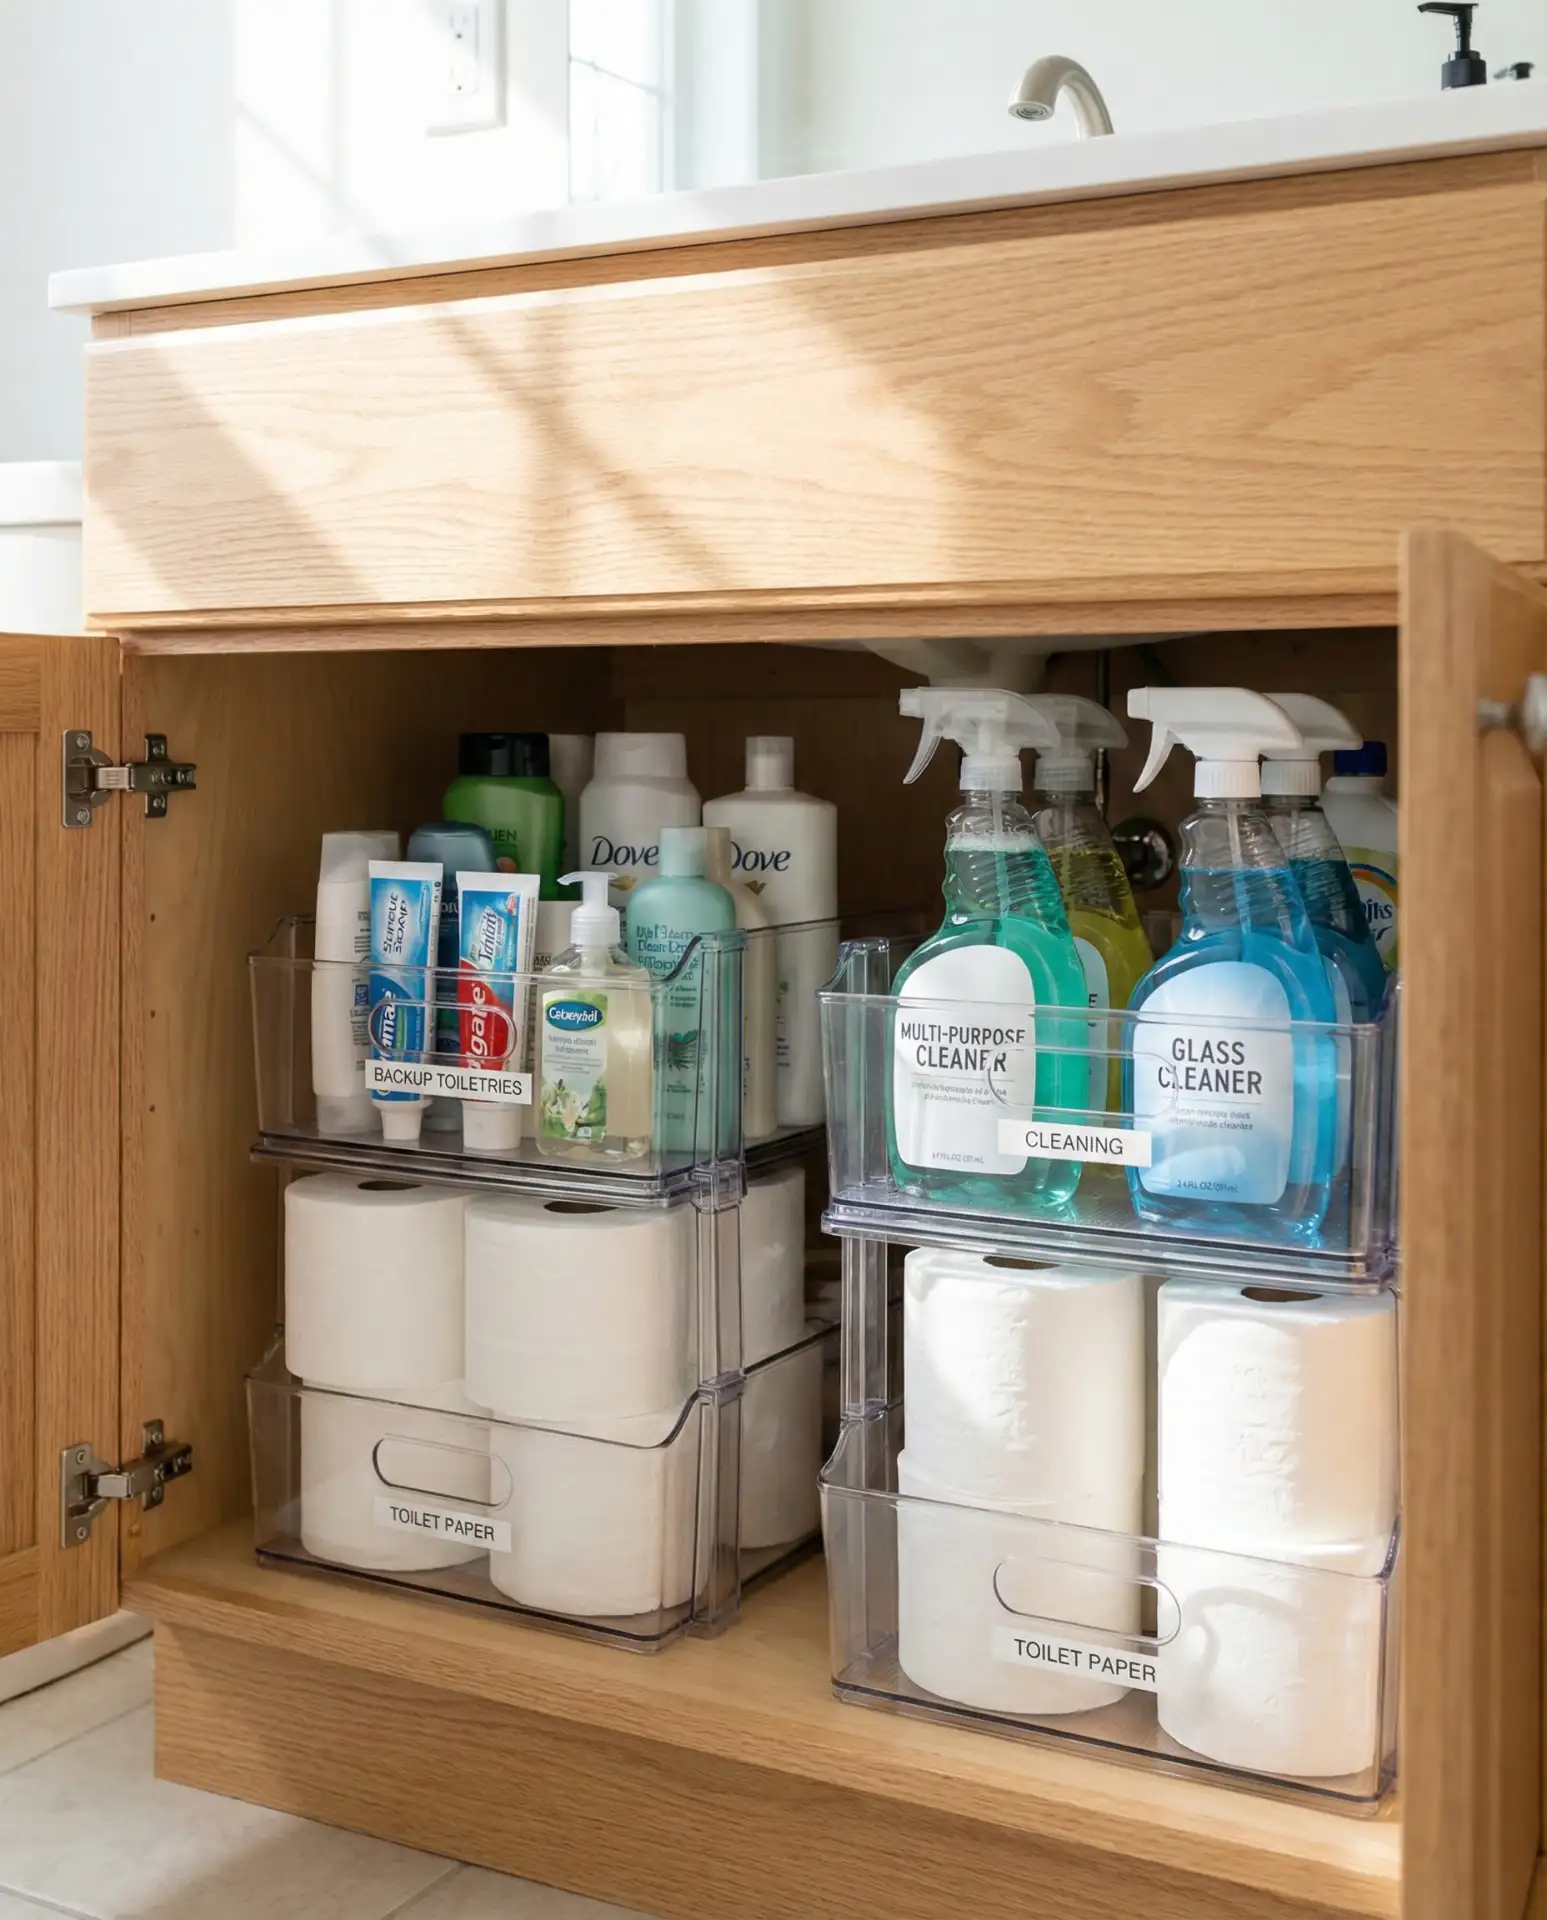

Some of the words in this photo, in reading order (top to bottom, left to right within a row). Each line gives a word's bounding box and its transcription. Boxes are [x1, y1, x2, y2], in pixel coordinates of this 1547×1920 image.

[591, 836, 660, 866] Dove
[901, 1022, 1026, 1046] MULTI-PURPOSE
[916, 1044, 1007, 1072] CLEANER
[1172, 1037, 1245, 1066] GLASS
[374, 1066, 433, 1087] BACKUP
[437, 1072, 523, 1096] TOILETRIES
[1158, 1065, 1263, 1096] CLEANER
[1025, 1130, 1124, 1156] CLEANING
[389, 1505, 441, 1530] TOILET
[445, 1517, 495, 1542] PAPER
[1014, 1638, 1083, 1667] TOILET
[1088, 1653, 1157, 1683] PAPER
